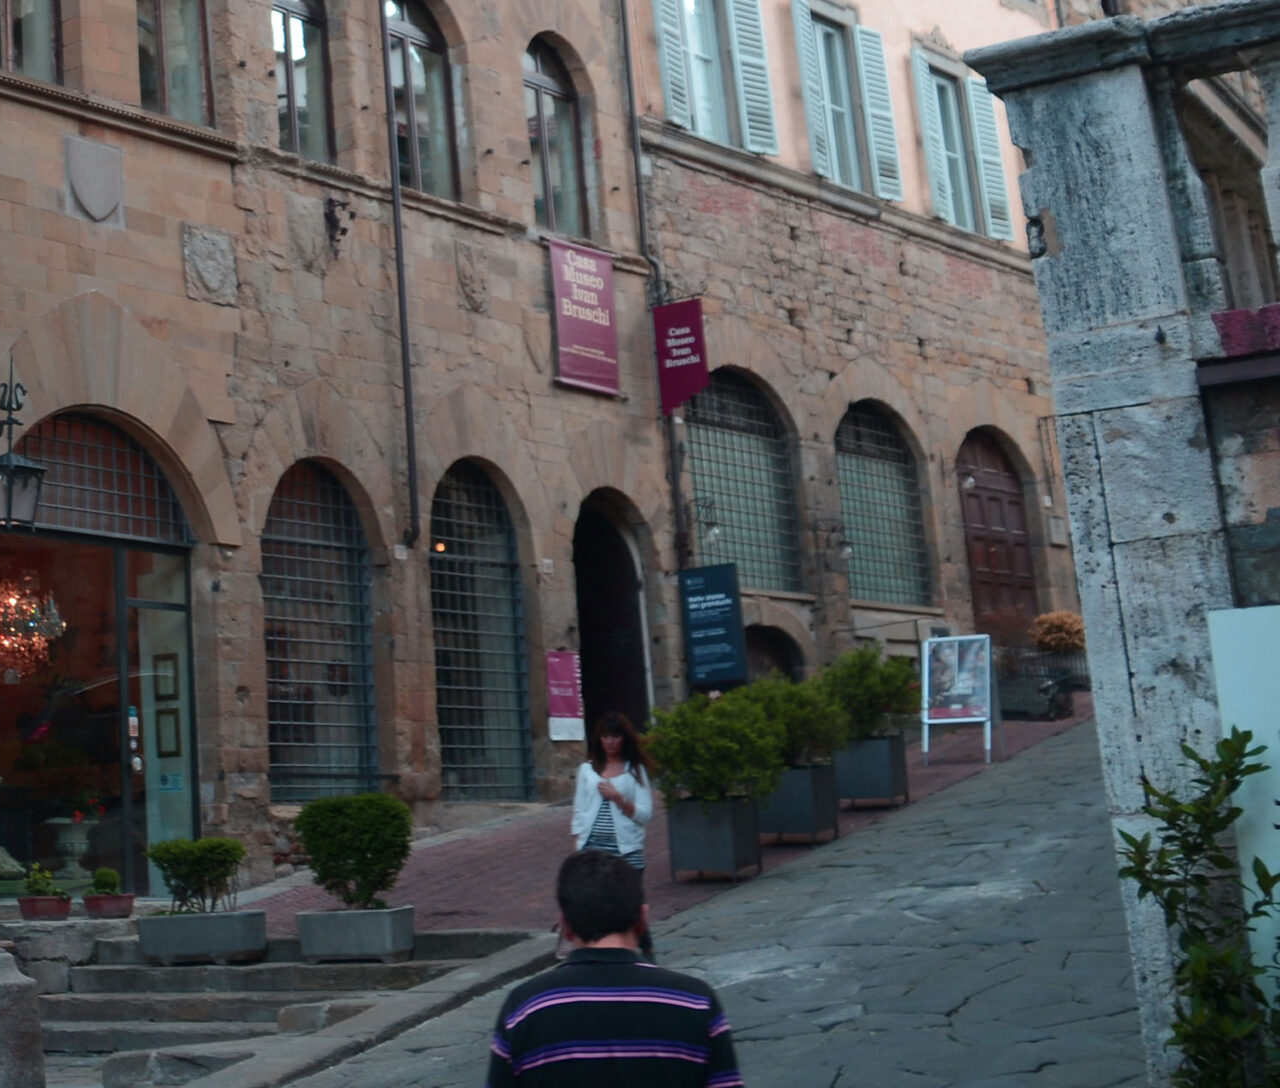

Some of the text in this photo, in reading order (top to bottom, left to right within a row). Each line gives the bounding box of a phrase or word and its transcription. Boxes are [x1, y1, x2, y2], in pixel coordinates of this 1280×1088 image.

[567, 250, 597, 272] Casa
[562, 264, 604, 290] Museo
[572, 284, 598, 305] Ivan
[562, 298, 610, 326] Bruschi
[668, 326, 691, 336] Casa
[666, 336, 695, 347] Museo
[672, 347, 691, 356] Ivan
[665, 354, 700, 368] Bruschi
